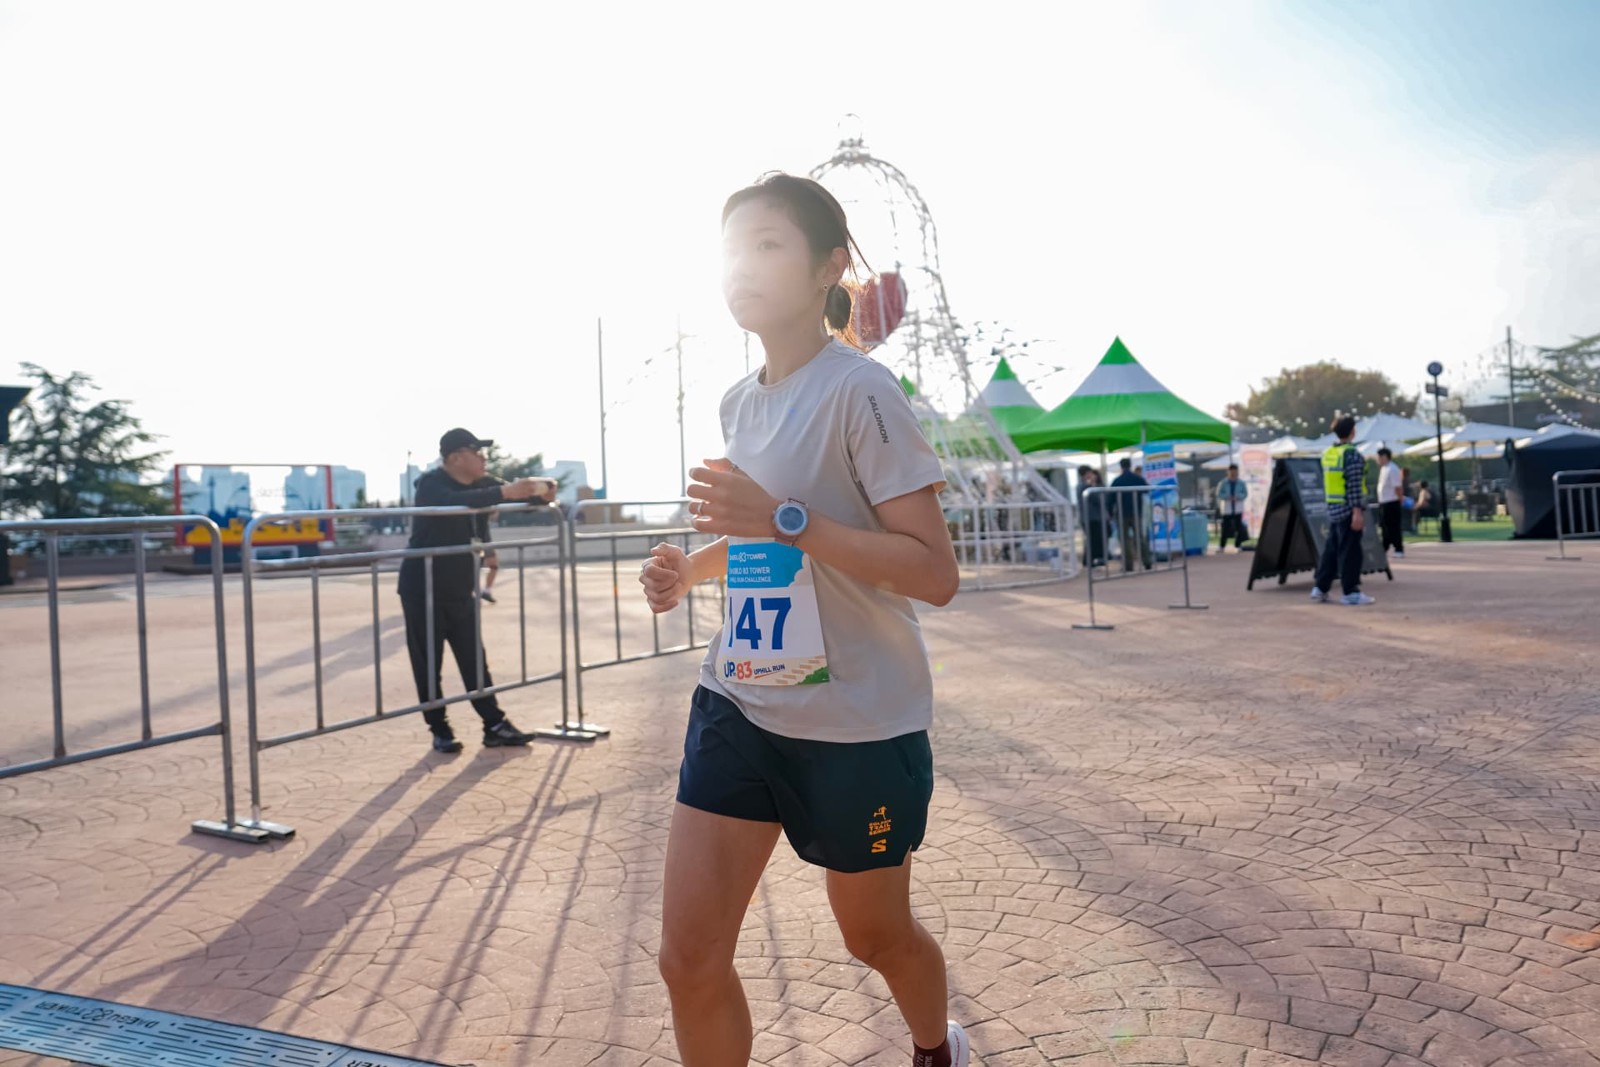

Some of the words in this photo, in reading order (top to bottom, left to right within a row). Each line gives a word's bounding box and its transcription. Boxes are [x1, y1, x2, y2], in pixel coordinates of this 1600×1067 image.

[867, 395, 890, 444] SALOMON
[736, 660, 753, 680] 83
[754, 667, 773, 676] UPHILL
[35, 1001, 83, 1017] TOWER
[113, 1013, 160, 1029] DAEGU
